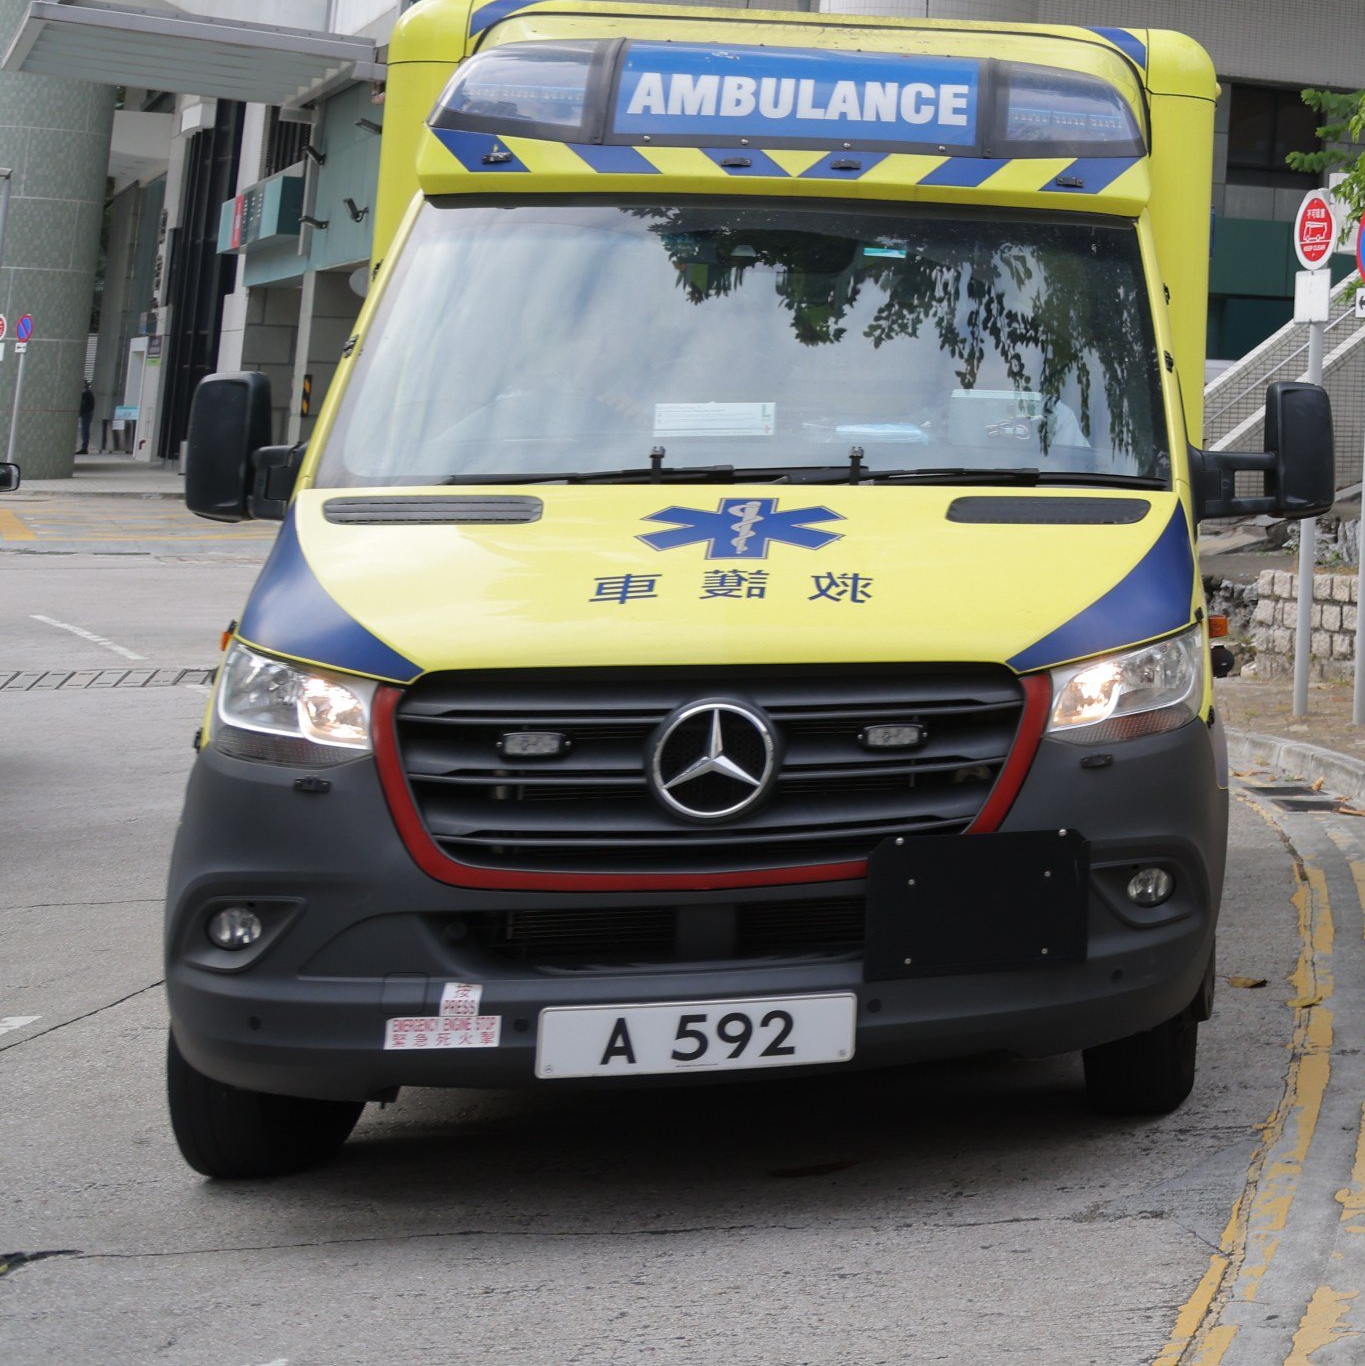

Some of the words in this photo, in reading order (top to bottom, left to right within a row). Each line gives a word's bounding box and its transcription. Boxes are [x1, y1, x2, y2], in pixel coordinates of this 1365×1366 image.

[626, 72, 969, 126] AMBULANCE
[392, 1018, 439, 1033] EMERGENCY
[443, 1017, 472, 1032] ENGINE
[475, 1016, 497, 1031] STOP
[443, 999, 476, 1015] PRESS
[599, 1016, 637, 1066] A
[670, 1009, 796, 1062] 592
